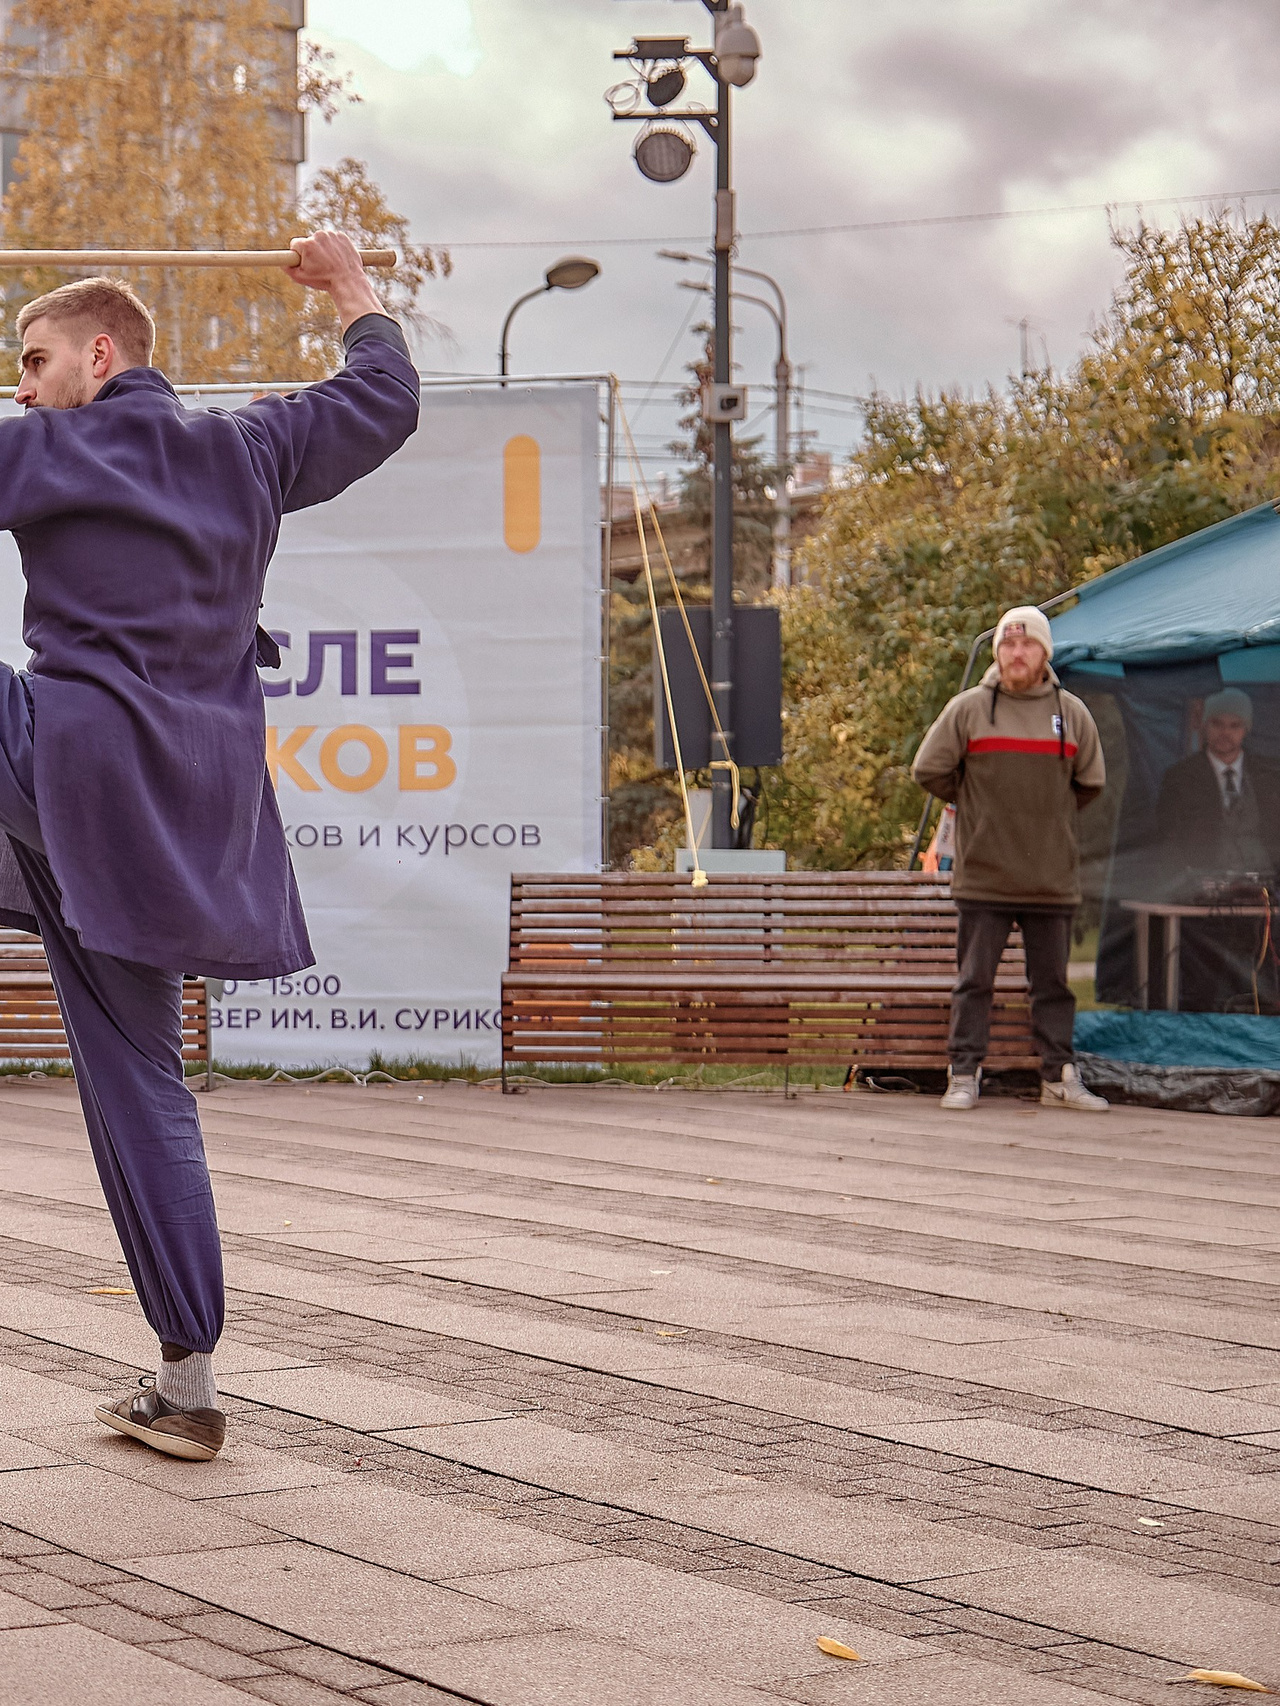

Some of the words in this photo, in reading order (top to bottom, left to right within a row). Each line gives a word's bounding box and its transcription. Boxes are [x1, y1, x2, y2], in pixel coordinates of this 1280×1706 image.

[360, 825, 380, 847] и
[397, 823, 541, 855] курсов
[269, 975, 341, 995] 15:00
[271, 1008, 320, 1029] ИМ.
[330, 1008, 384, 1029] В.И.
